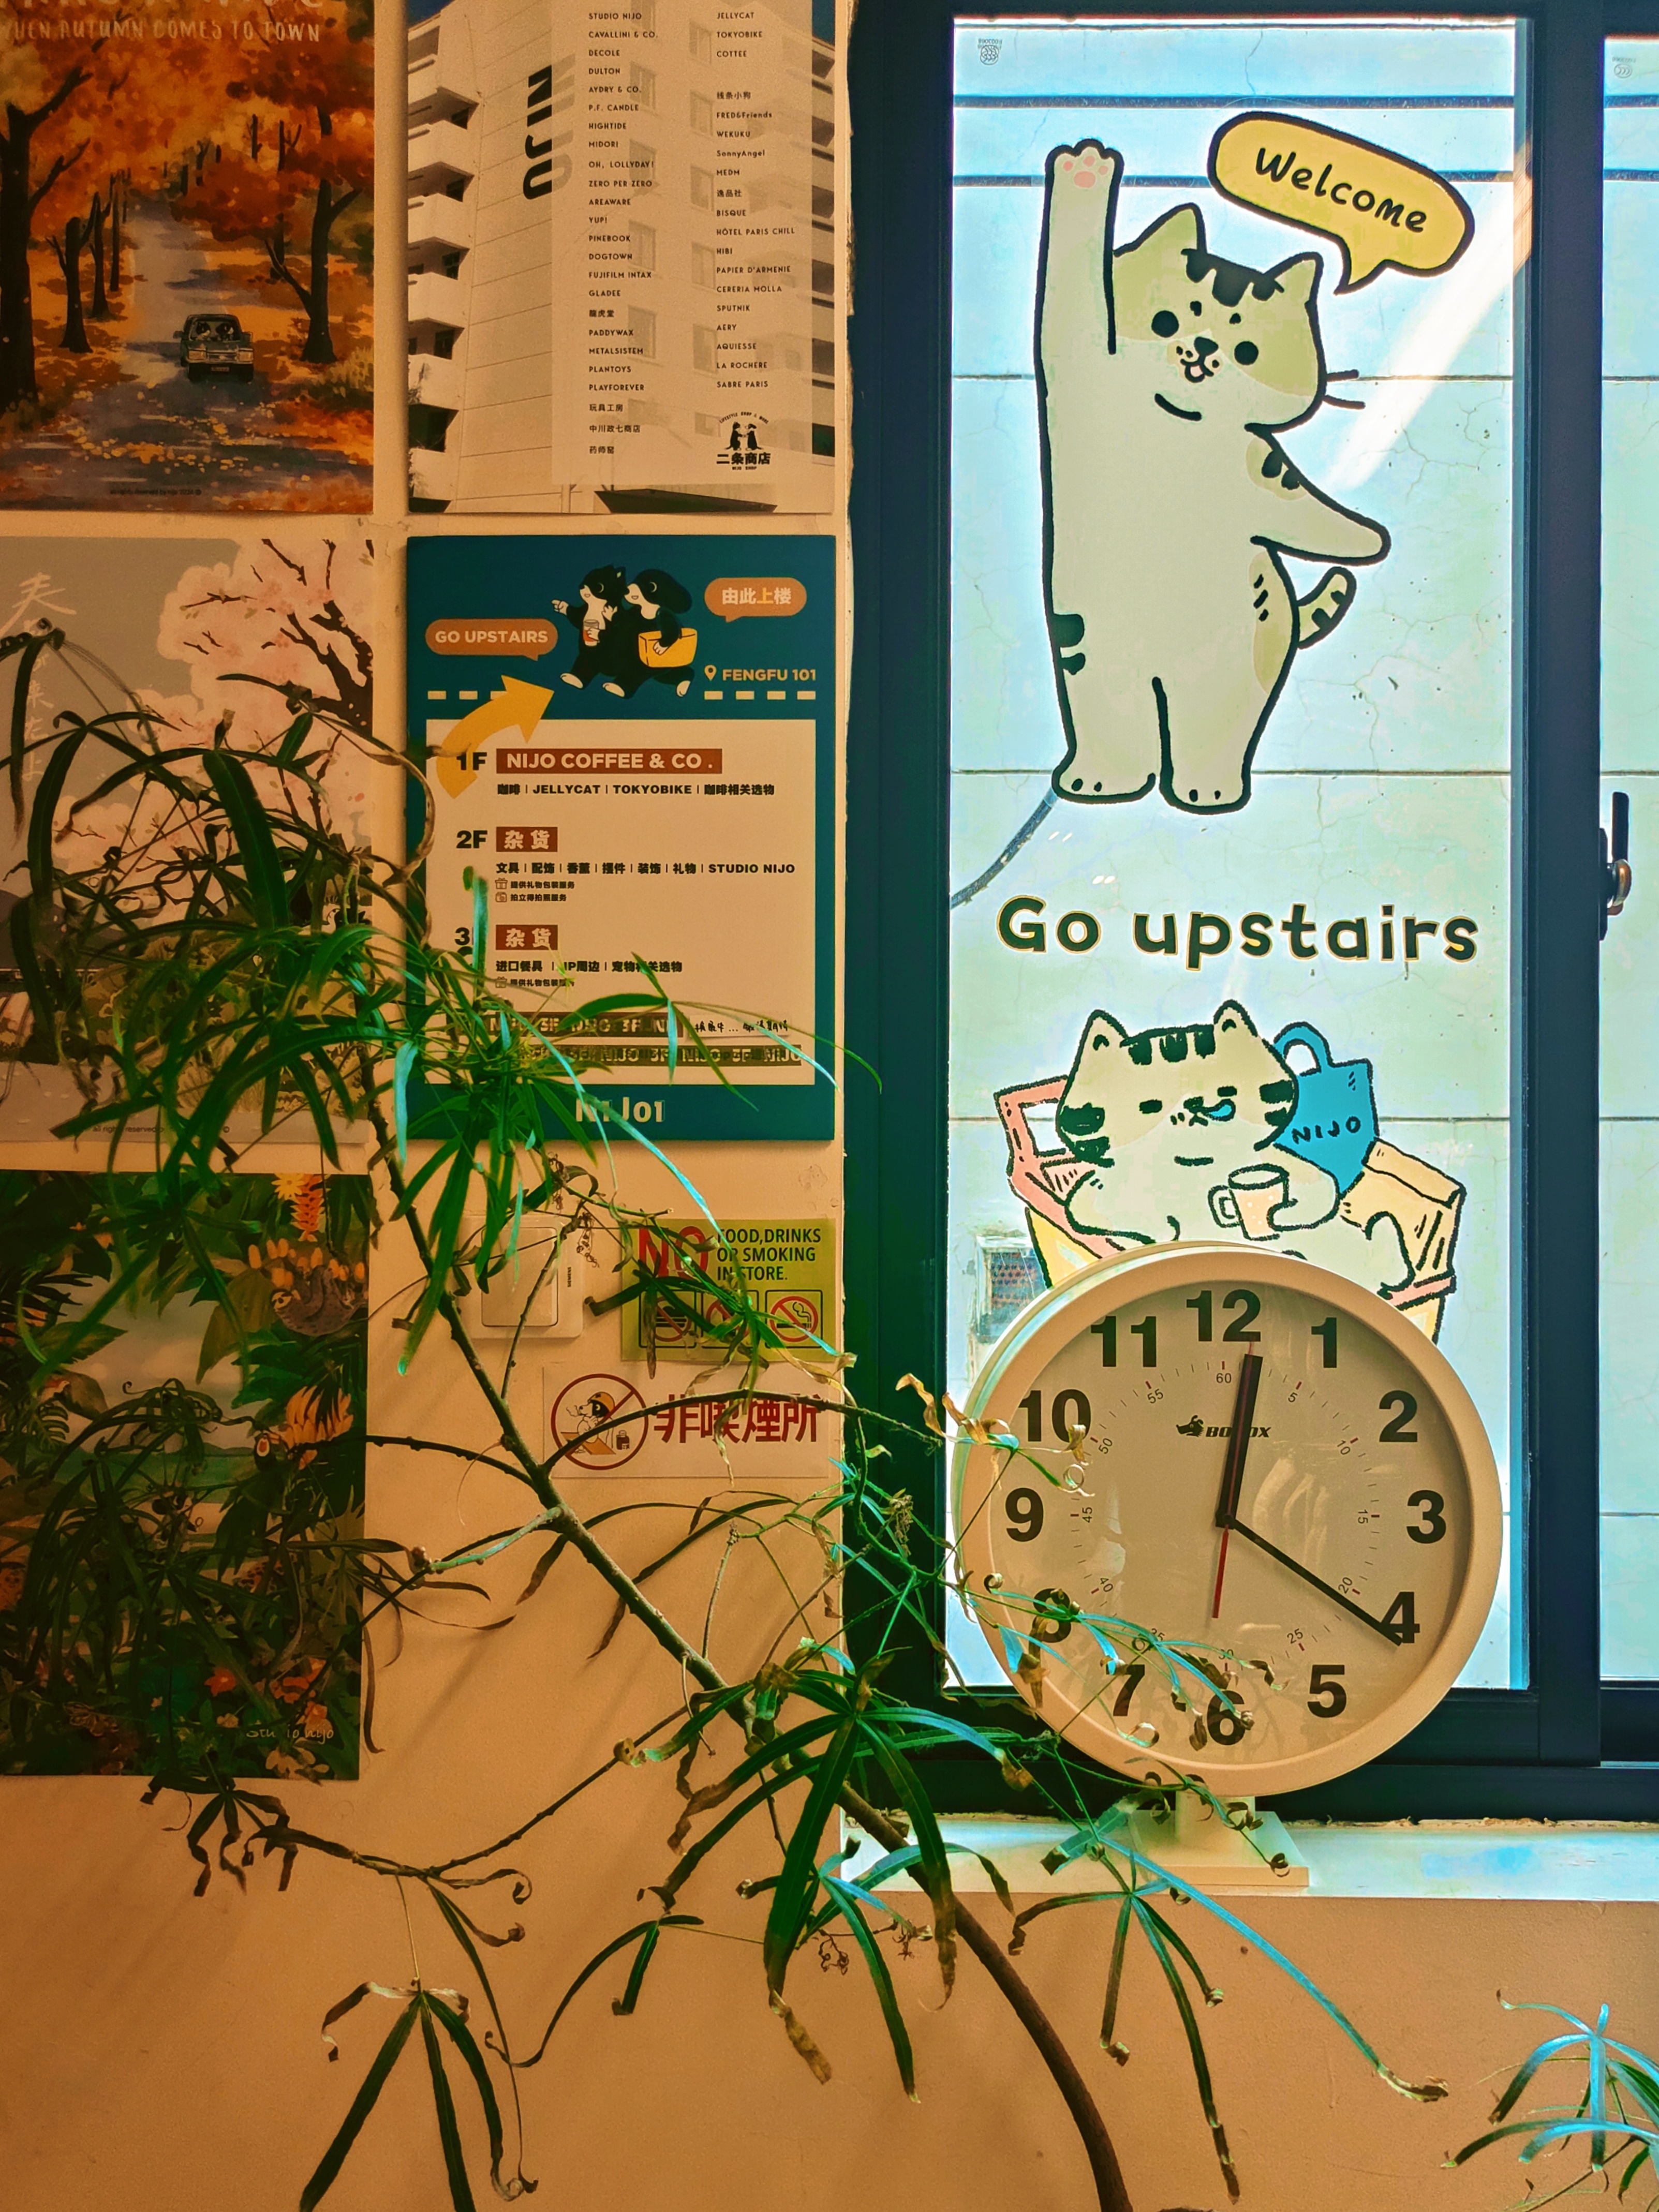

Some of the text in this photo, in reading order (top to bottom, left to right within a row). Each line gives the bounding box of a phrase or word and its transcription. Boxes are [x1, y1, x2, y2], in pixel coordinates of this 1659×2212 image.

[60, 21, 143, 39] AUTUMN
[155, 21, 223, 39] COMES
[233, 21, 253, 40] TO
[263, 21, 319, 41] TOWN
[523, 53, 575, 199] NIJO
[717, 149, 765, 158] SonnyAngel
[1255, 146, 1428, 234] Welcome
[589, 404, 623, 412] 玩具工房
[589, 424, 640, 433] 中川政七商店
[722, 587, 791, 605] 由此上楼
[435, 630, 548, 643] GO UPSTAIRS
[723, 669, 816, 681] FENGFU 101
[456, 752, 487, 770] 1F
[508, 753, 555, 768] NIJO
[561, 753, 643, 768] COFFEE
[649, 753, 665, 768] &
[497, 783, 774, 795] 咖啡 JELLYCAT TOKYOBIKE 咖啡相关选物
[456, 830, 487, 849] 2F
[496, 863, 795, 874] 文具 配饰 香薰 摆件 装饰 礼物 STUDIO NIJO
[997, 896, 1479, 971] Go upstairs
[496, 960, 542, 972] 进口餐具
[1292, 1116, 1361, 1143] NIJO
[639, 1228, 708, 1280] NO
[743, 1247, 815, 1261] SMOKING
[717, 1266, 732, 1281] IN
[1186, 1289, 1262, 1342] 12
[1090, 1316, 1157, 1368] 11
[1311, 1317, 1338, 1368] 1
[1216, 1373, 1232, 1383] 60
[1147, 1387, 1163, 1404] 55
[1288, 1392, 1298, 1403] 5
[1018, 1389, 1092, 1443] 10
[1379, 1391, 1418, 1443] 2
[1098, 1438, 1113, 1454] 50
[1339, 1439, 1352, 1455] 10
[1005, 1488, 1044, 1542] 9
[1082, 1507, 1092, 1523] 45
[1358, 1509, 1368, 1524] 15
[1406, 1490, 1447, 1543] 3
[1099, 1577, 1114, 1593] 40
[1338, 1577, 1353, 1594] 20
[1383, 1592, 1420, 1644] 4
[1287, 1628, 1303, 1642] 25
[1106, 1665, 1145, 1717] 7
[1307, 1665, 1346, 1718] 5
[1206, 1690, 1246, 1746] 6
